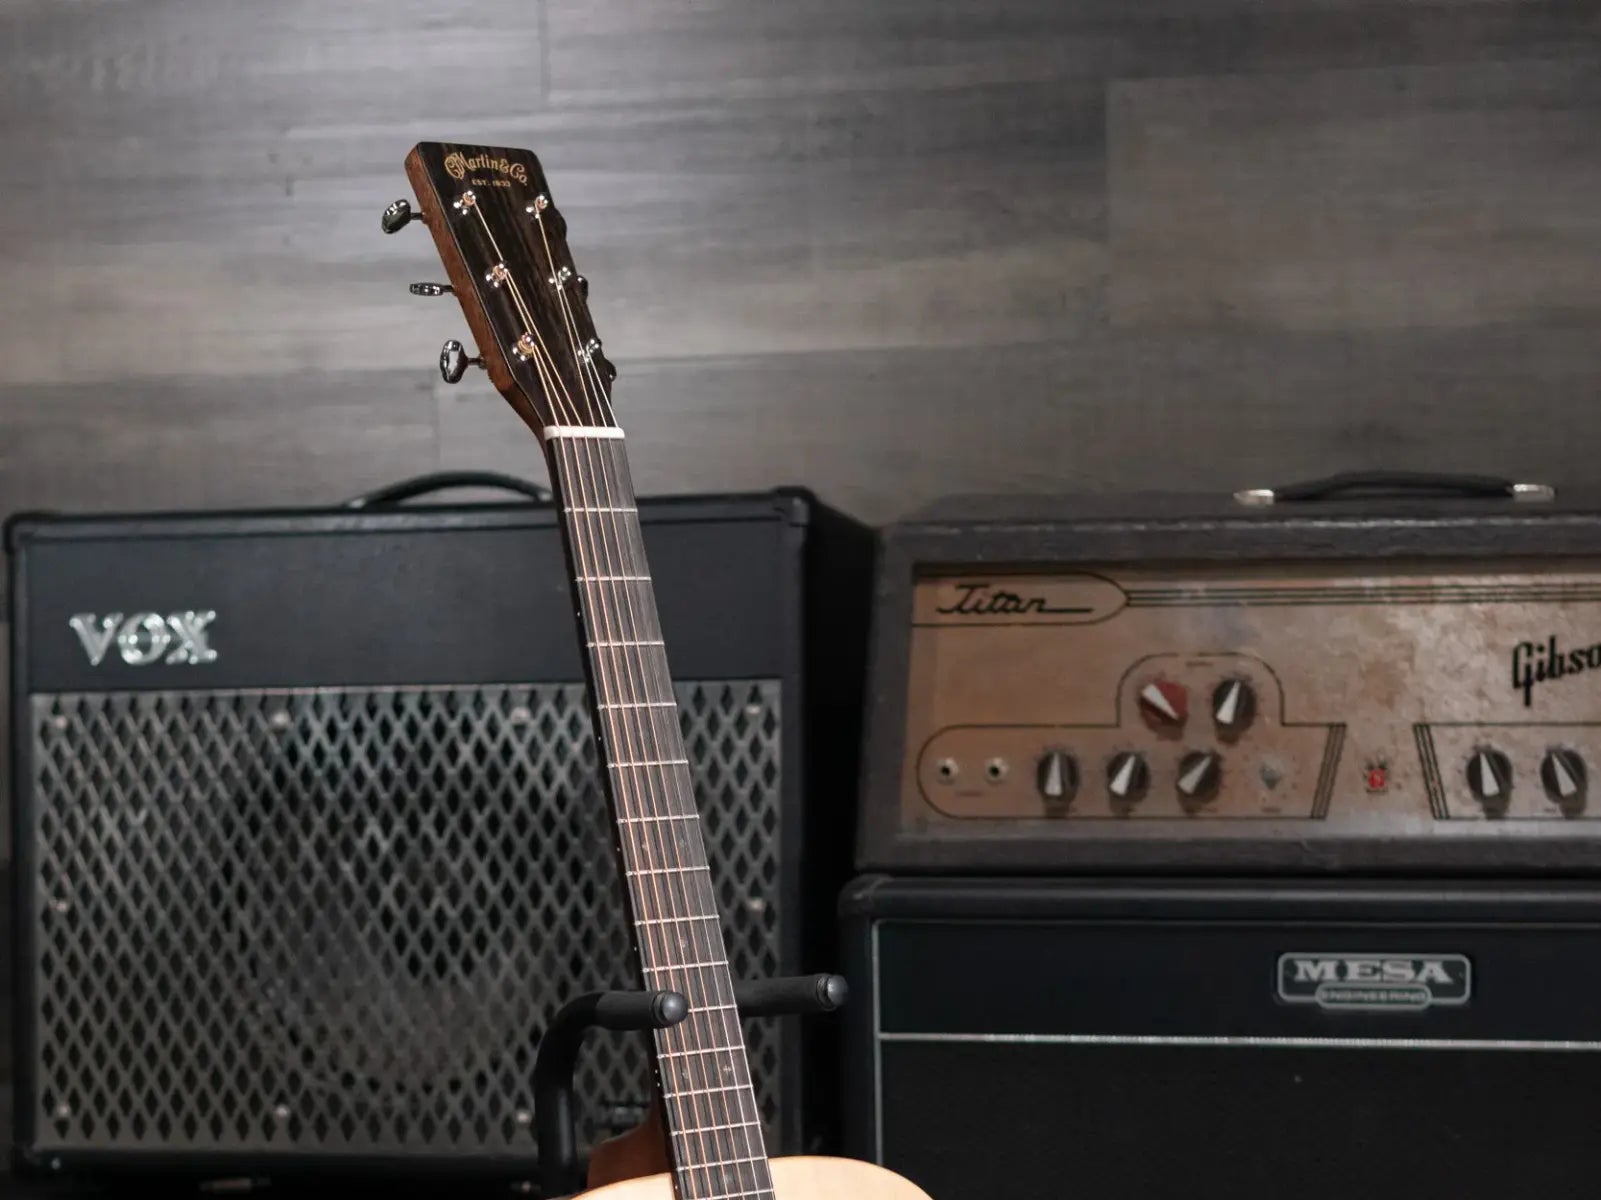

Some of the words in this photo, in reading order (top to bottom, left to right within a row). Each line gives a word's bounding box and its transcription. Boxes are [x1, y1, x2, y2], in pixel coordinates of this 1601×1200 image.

[936, 584, 1094, 614] Titan
[69, 610, 217, 666] VOX
[1294, 960, 1453, 984] MESA
